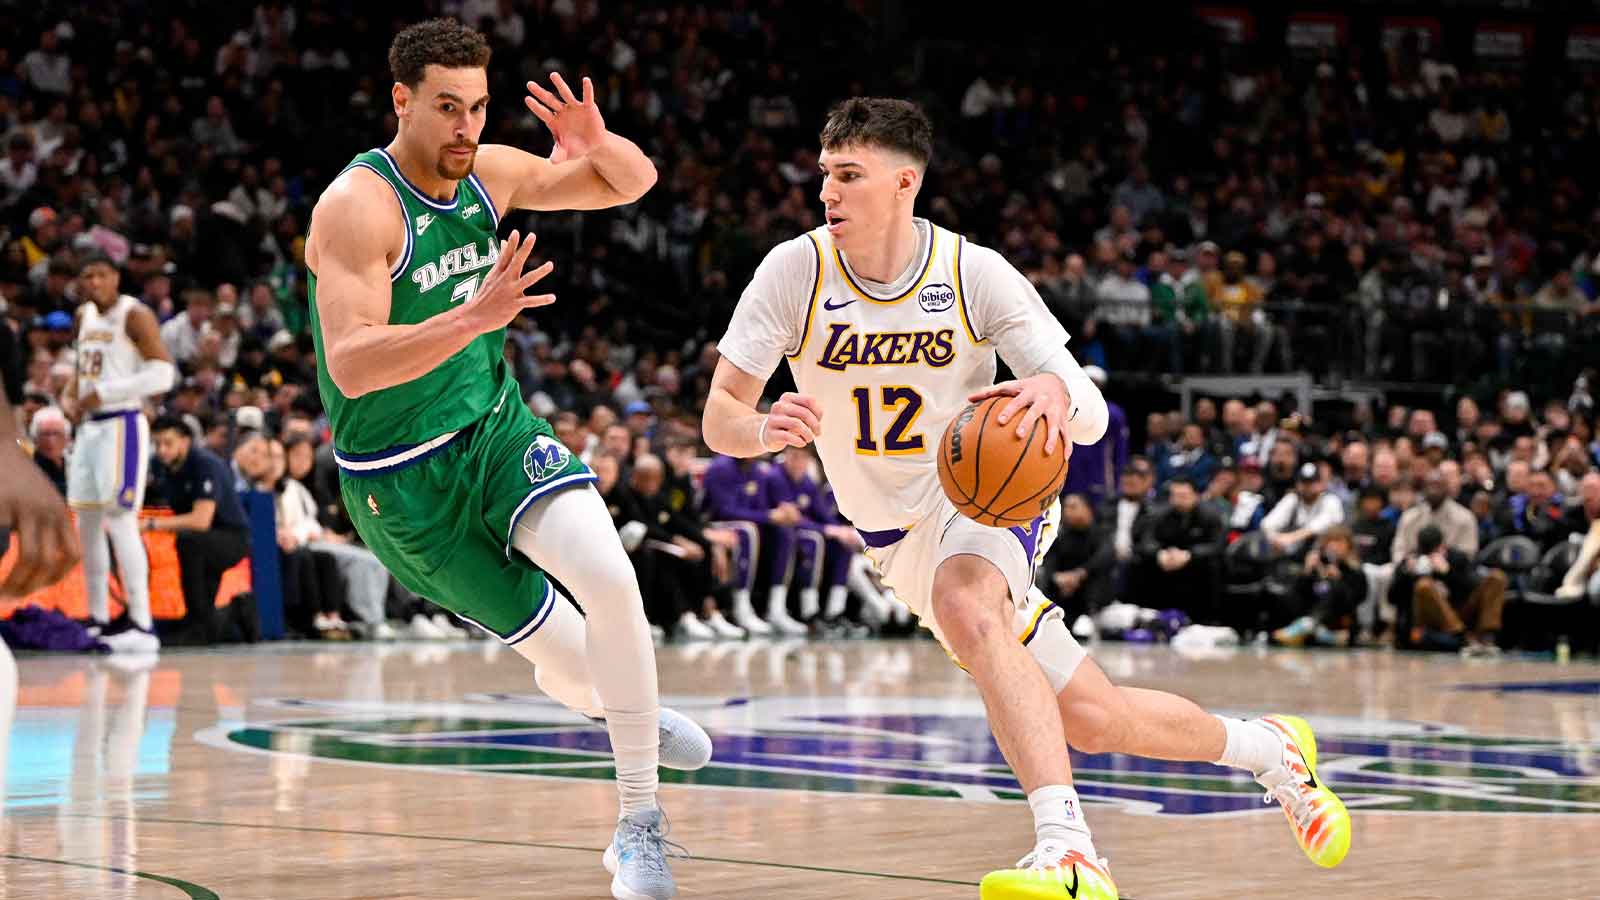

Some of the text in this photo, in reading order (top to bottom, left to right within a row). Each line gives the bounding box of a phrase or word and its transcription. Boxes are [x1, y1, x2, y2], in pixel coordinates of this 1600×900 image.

[411, 236, 500, 293] DALLA
[921, 291, 953, 303] bibigo
[817, 323, 956, 371] LAKERS
[851, 385, 926, 456] 12
